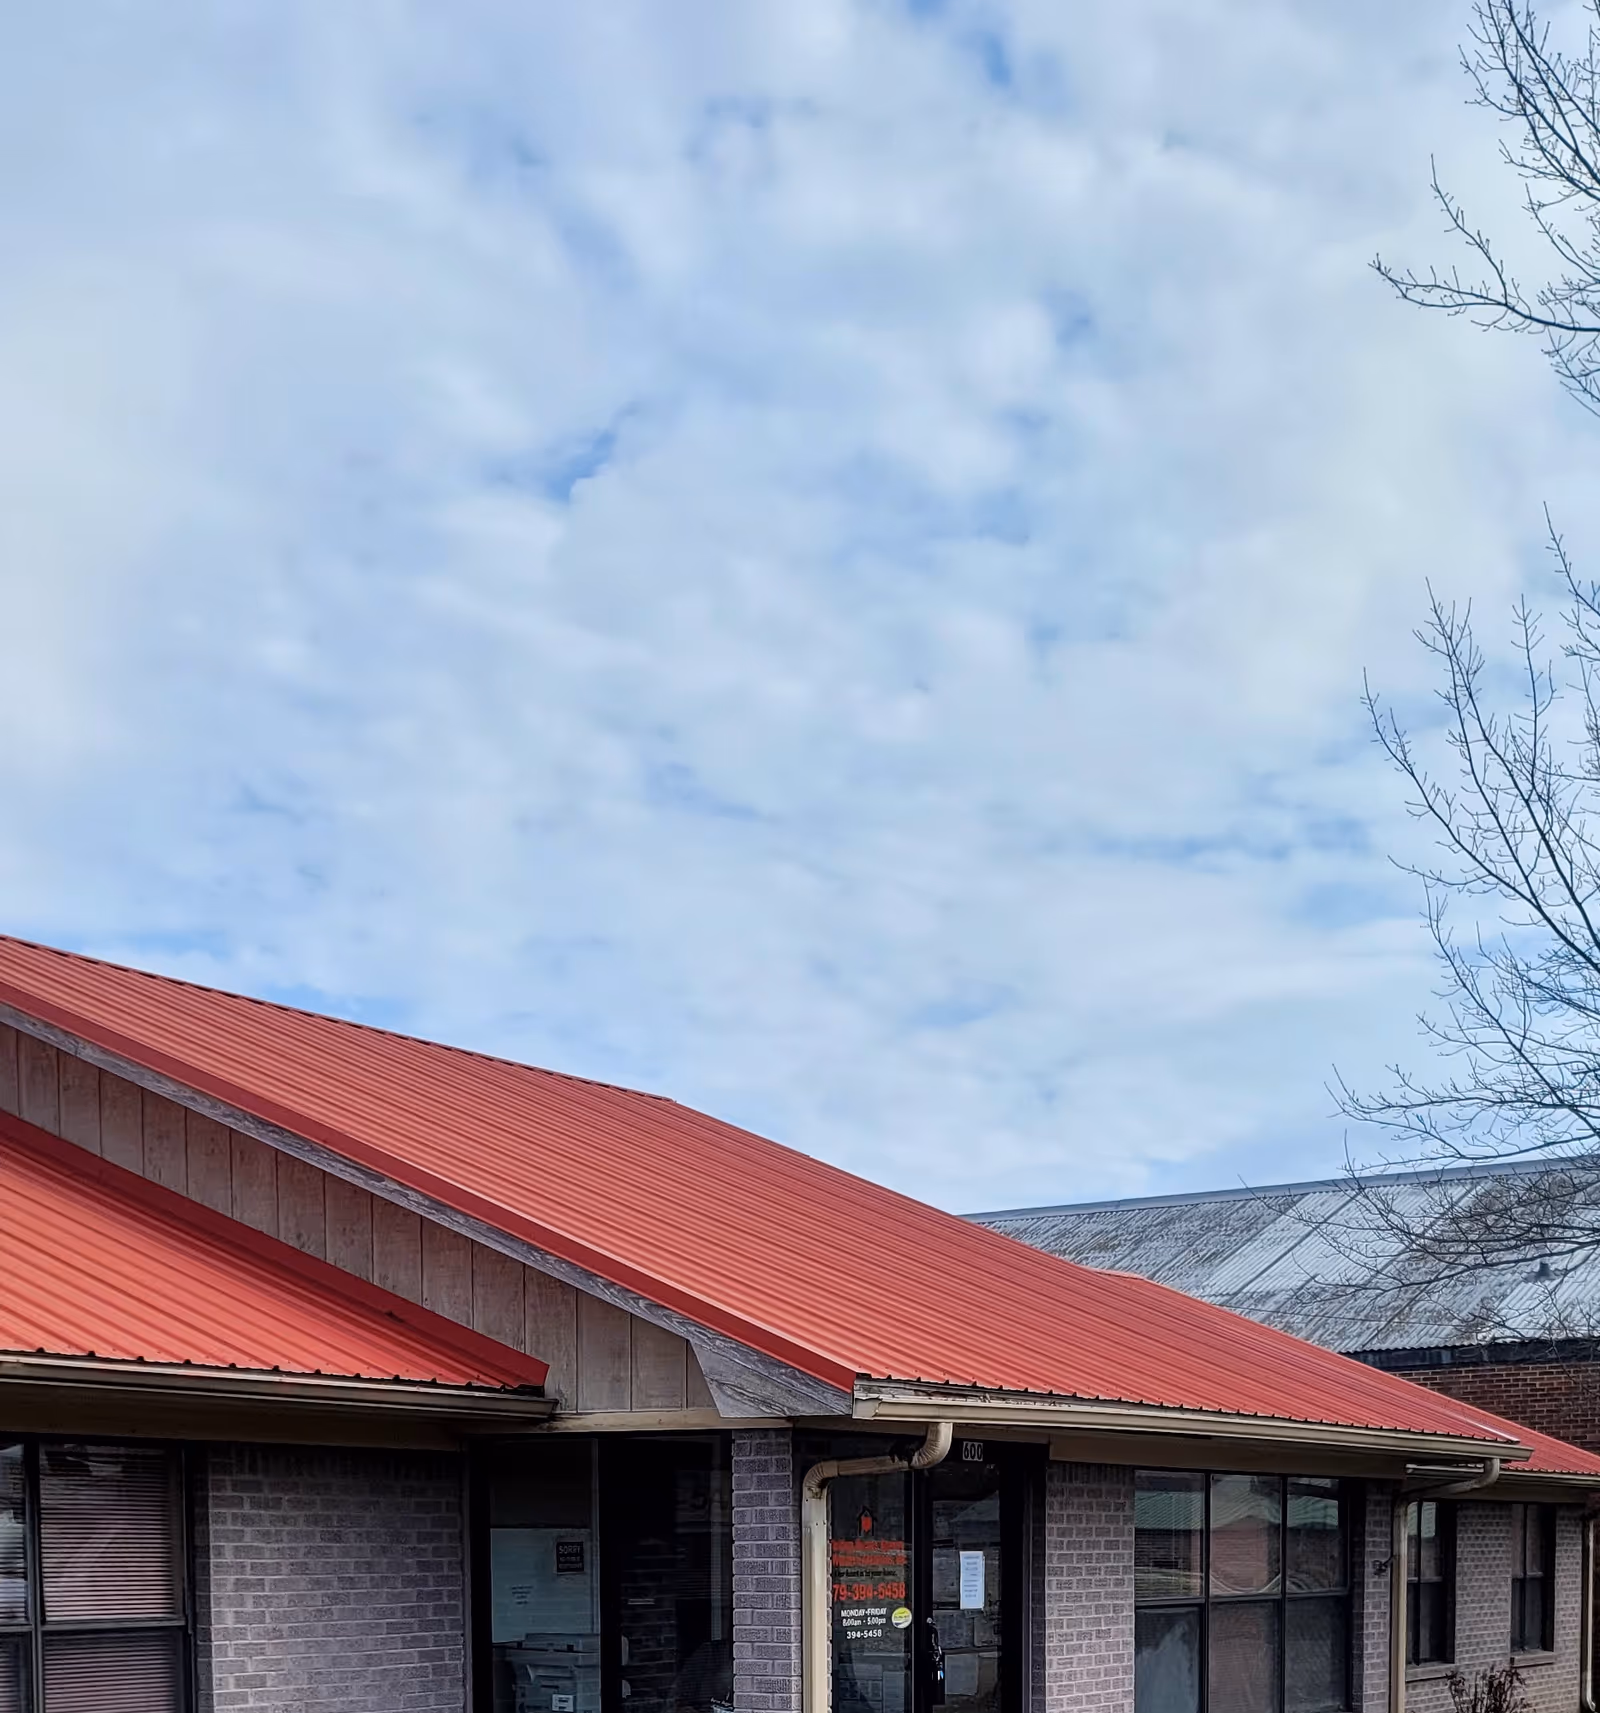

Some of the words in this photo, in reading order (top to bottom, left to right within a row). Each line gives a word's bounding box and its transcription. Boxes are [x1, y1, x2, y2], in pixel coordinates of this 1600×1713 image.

[962, 1441, 978, 1456] 600
[558, 1545, 580, 1554] SORRY
[832, 1582, 906, 1602] 79-394-5458
[846, 1629, 882, 1639] 394-5458
